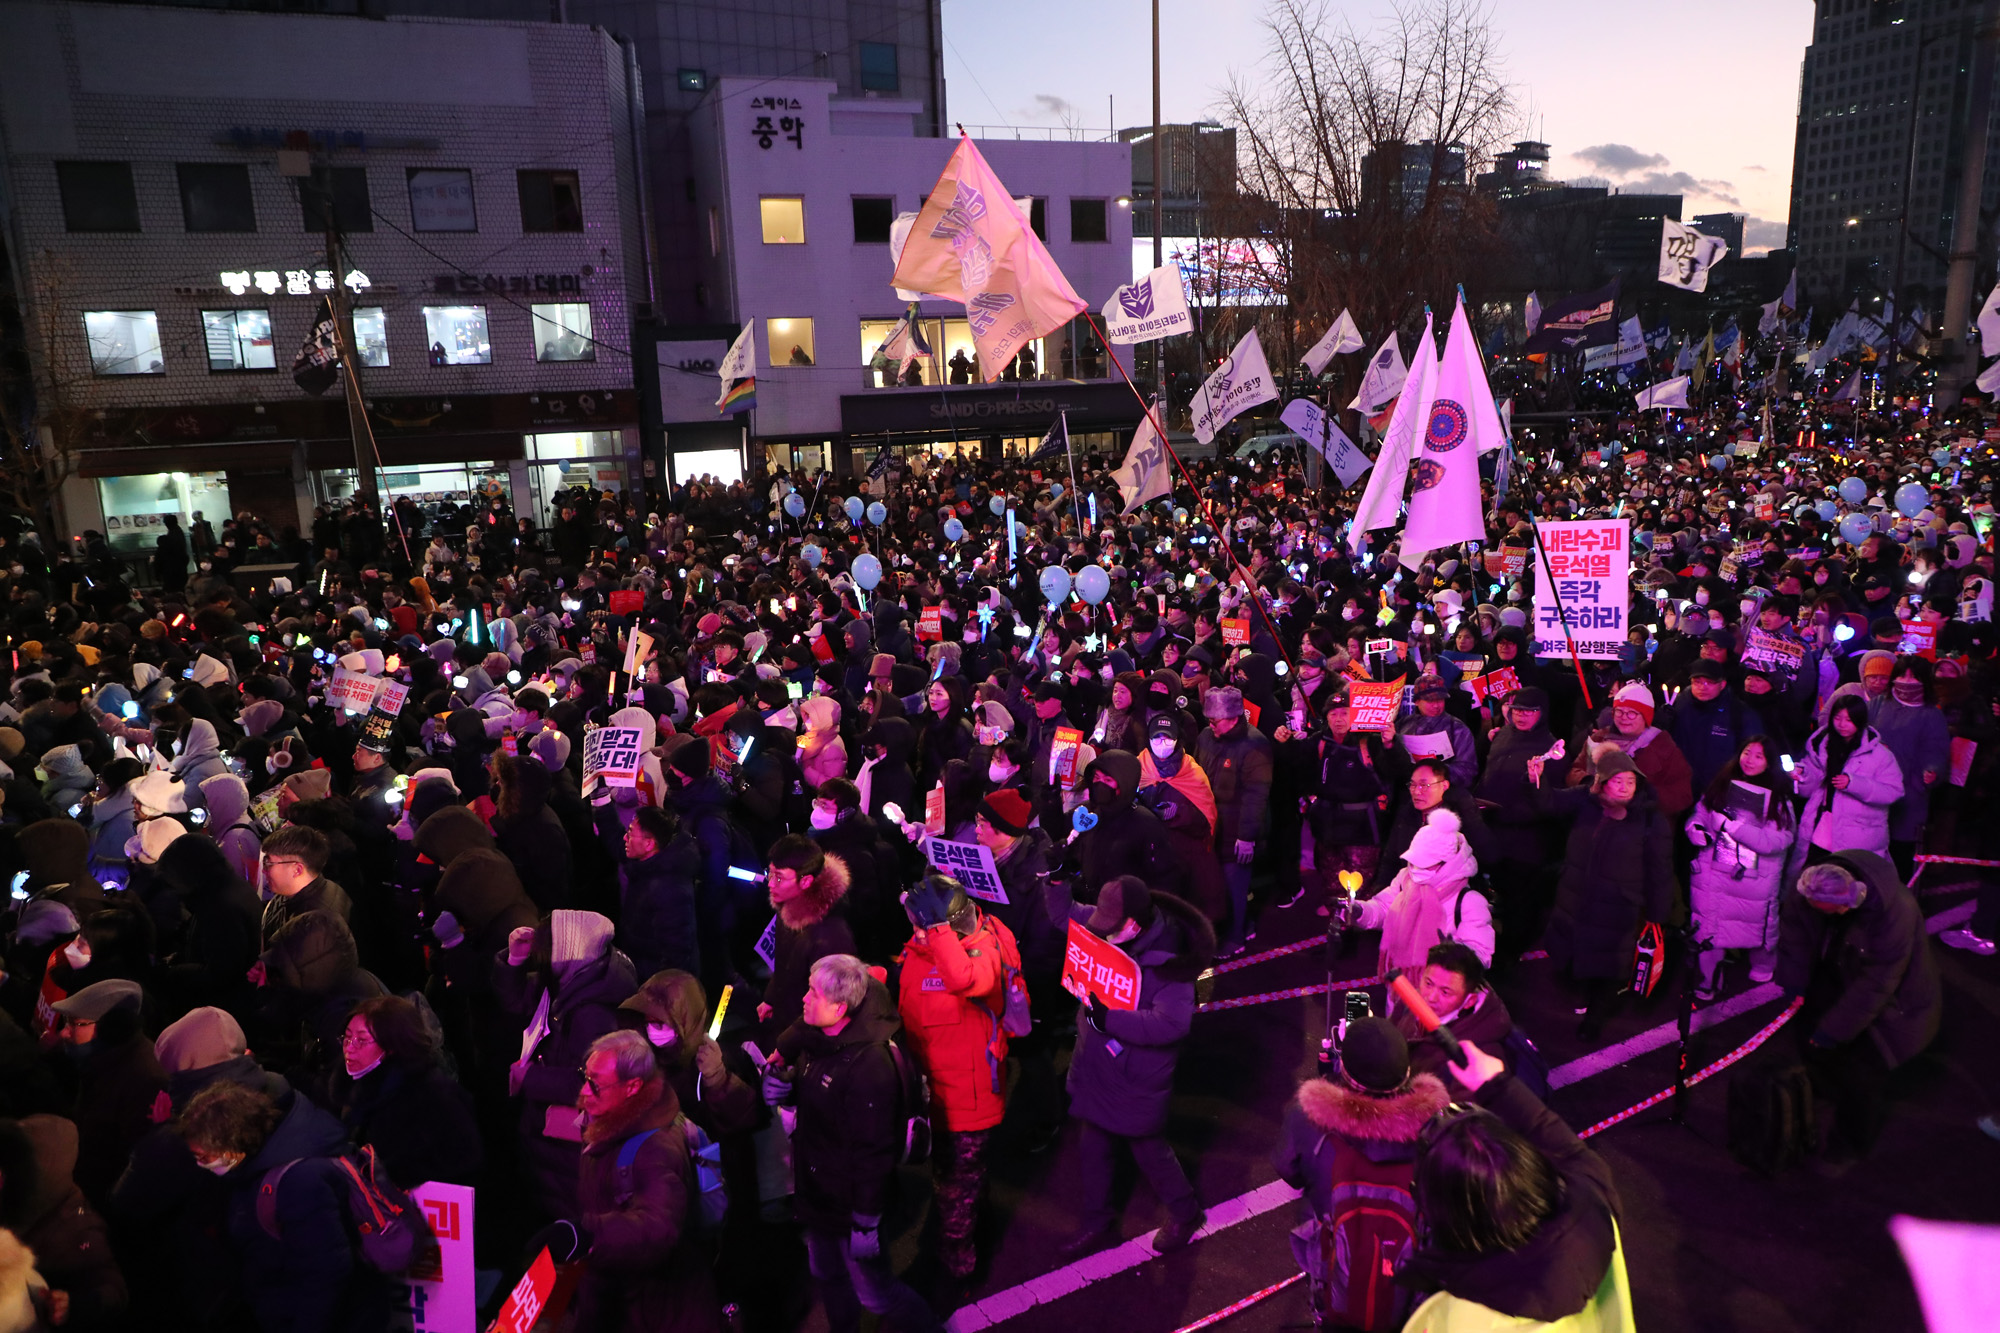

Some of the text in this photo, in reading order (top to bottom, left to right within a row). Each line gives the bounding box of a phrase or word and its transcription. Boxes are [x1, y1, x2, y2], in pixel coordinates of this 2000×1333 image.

[751, 97, 802, 110] 스페이스
[752, 116, 804, 150] 중학
[930, 402, 974, 417] SAND
[996, 399, 1056, 415] PRESSO
[1540, 528, 1622, 552] 내란수괴
[1550, 554, 1611, 578] 윤석열
[1560, 581, 1602, 604] 즉각
[1540, 606, 1622, 629] 구속하라
[345, 679, 376, 693] 특검으로
[1352, 685, 1392, 696] 내란수괴
[350, 690, 372, 703] 처벌!
[379, 698, 401, 712] 처벌!
[1351, 695, 1391, 709] 헌재는
[364, 722, 393, 739] 구속!
[600, 729, 640, 749] 받고
[610, 750, 638, 769] 더!
[932, 841, 984, 870] 윤석열
[952, 868, 999, 894] 체포!
